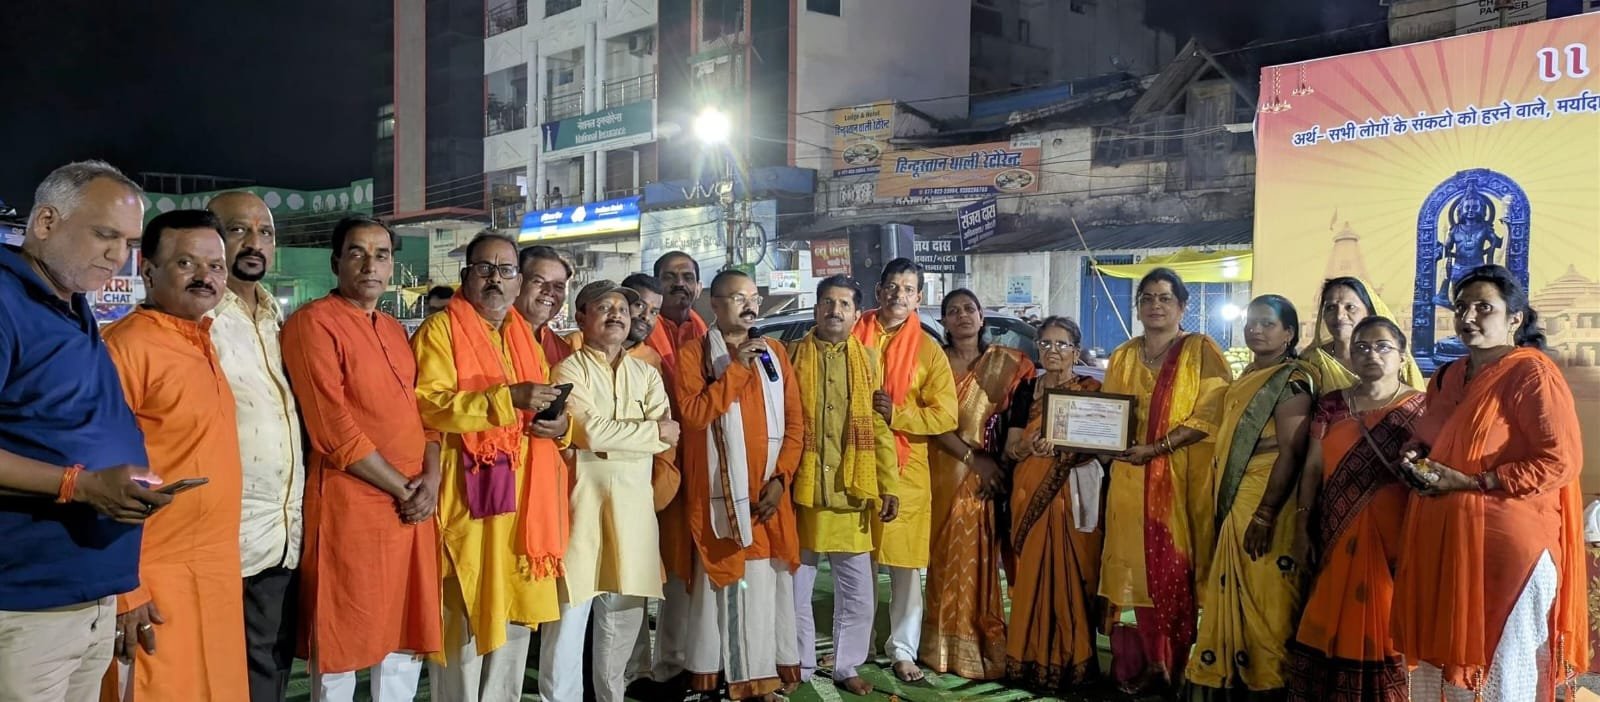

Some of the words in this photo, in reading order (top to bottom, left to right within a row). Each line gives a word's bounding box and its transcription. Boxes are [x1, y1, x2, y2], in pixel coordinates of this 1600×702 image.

[1329, 122, 1356, 141] सभी
[1360, 117, 1392, 137] लोगों
[1393, 116, 1407, 133] के
[1412, 110, 1453, 132] संकटो
[1457, 107, 1477, 125] को
[1481, 102, 1511, 124] हरने
[1516, 97, 1550, 118] वाले,
[682, 181, 733, 200] vivo
[960, 209, 981, 230] संजय
[981, 203, 996, 221] दास
[932, 240, 951, 252] दास
[103, 293, 131, 303] CHAT
